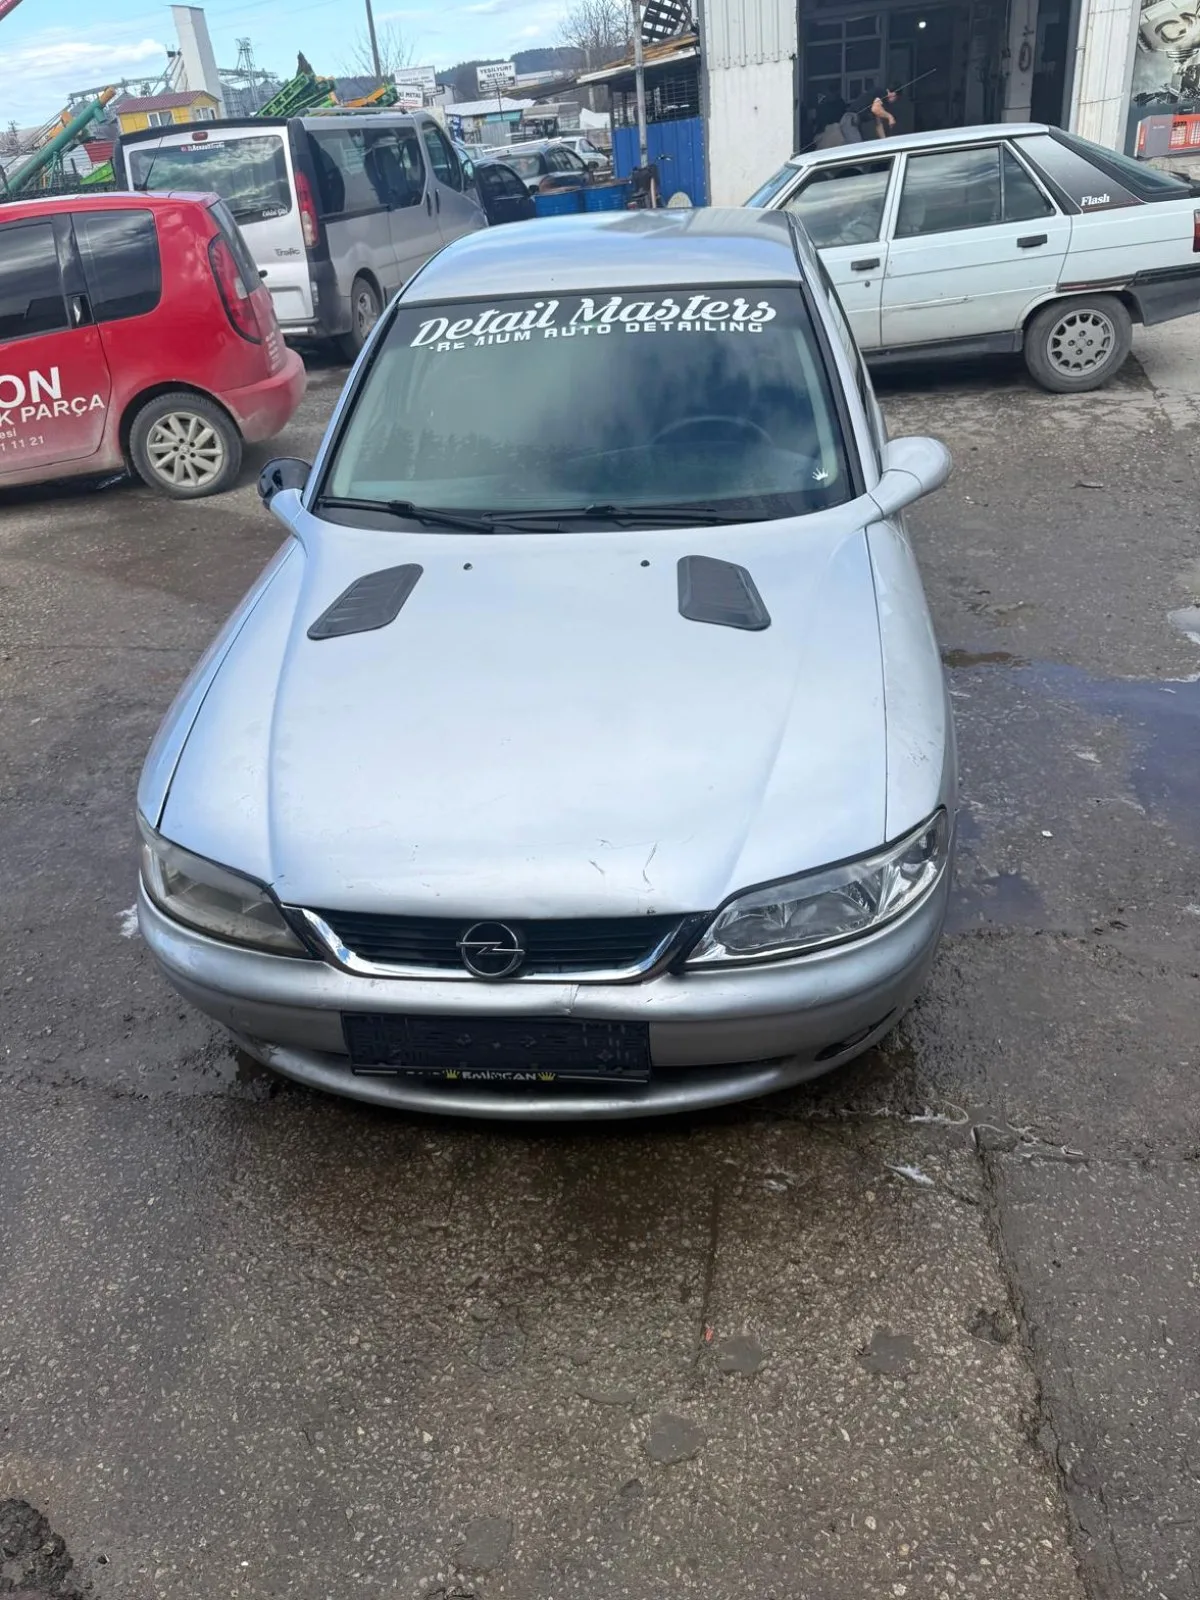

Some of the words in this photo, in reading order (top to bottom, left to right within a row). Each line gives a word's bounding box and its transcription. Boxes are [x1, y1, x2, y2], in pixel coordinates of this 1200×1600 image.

[1080, 193, 1110, 207] Flash
[409, 299, 560, 348] Detail
[569, 294, 777, 324] Masters
[544, 323, 612, 339] AUTO
[625, 321, 763, 334] DETAILING
[20, 393, 105, 423] PARÇA
[11, 439, 25, 450] 11
[29, 435, 45, 447] 21
